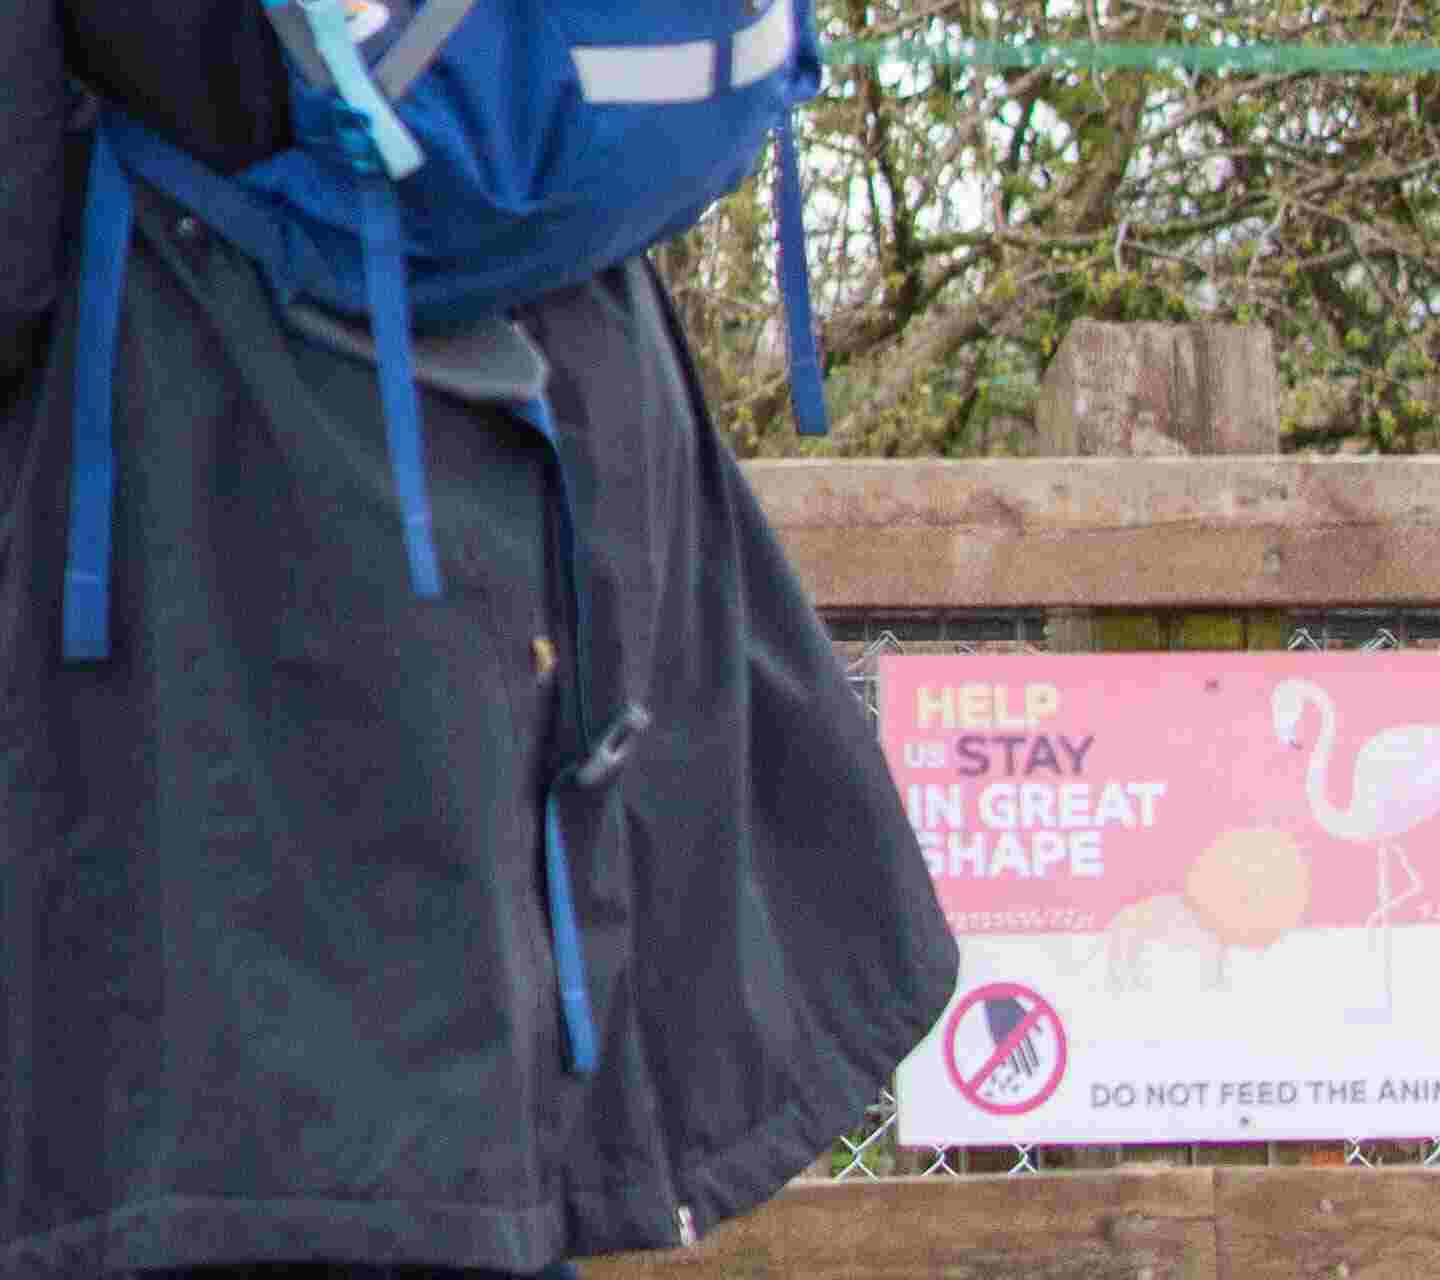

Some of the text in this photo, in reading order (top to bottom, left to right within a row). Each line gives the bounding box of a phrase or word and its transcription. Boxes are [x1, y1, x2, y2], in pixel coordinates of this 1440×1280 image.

[915, 683, 1058, 728] HELP
[955, 735, 1095, 776] STAY
[908, 783, 1168, 828] IN GREAT
[917, 832, 1104, 878] SHAPE
[1091, 1083, 1135, 1108] DO
[1146, 1083, 1208, 1107] NOT
[1221, 1081, 1297, 1105] FEED
[1305, 1080, 1366, 1104] THE
